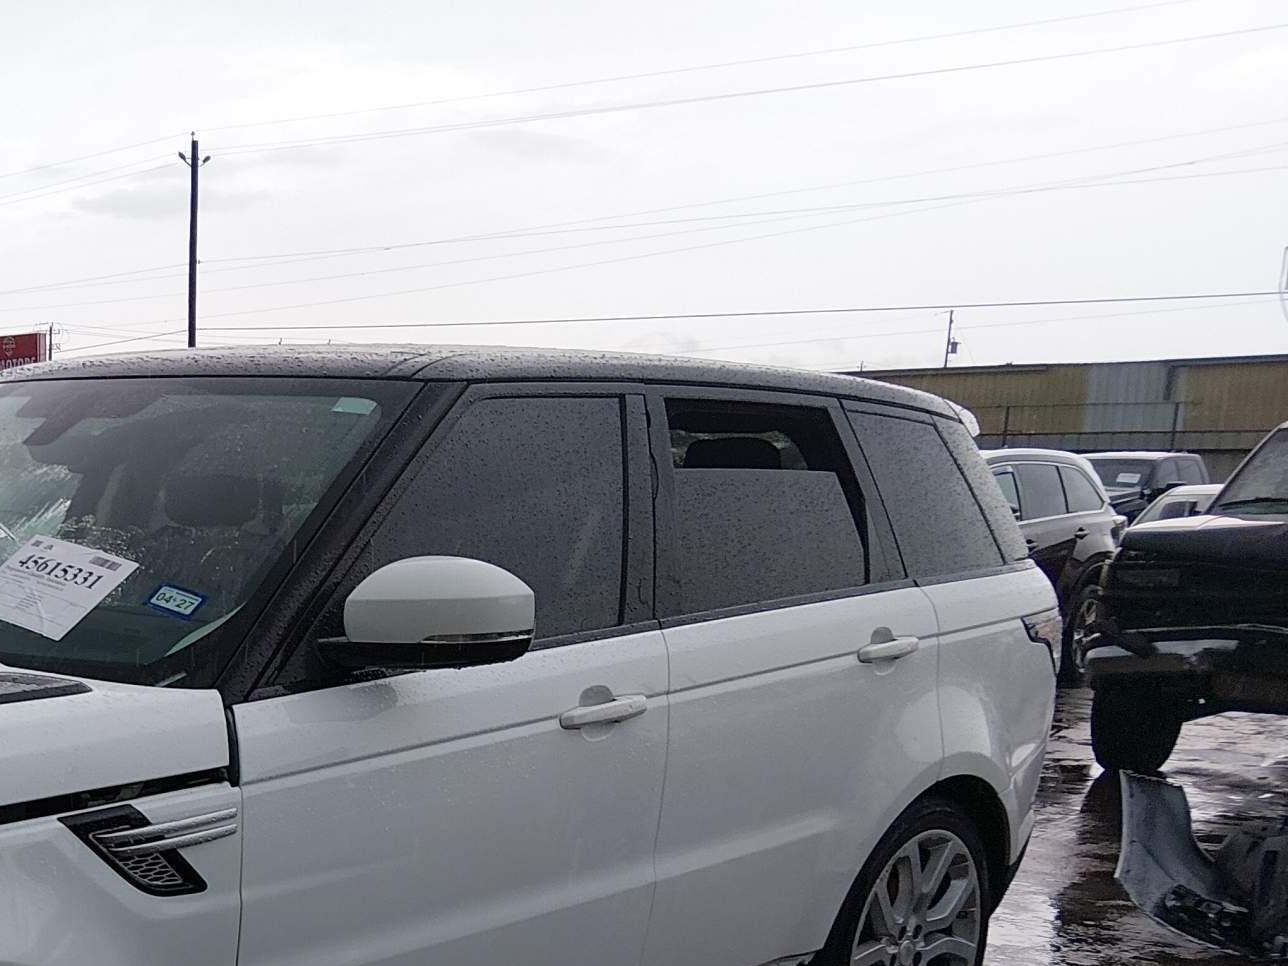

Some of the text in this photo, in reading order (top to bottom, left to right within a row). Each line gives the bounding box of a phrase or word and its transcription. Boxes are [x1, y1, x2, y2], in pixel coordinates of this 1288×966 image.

[18, 554, 104, 589] 45615331
[156, 592, 173, 603] 04
[175, 599, 195, 610] 27
